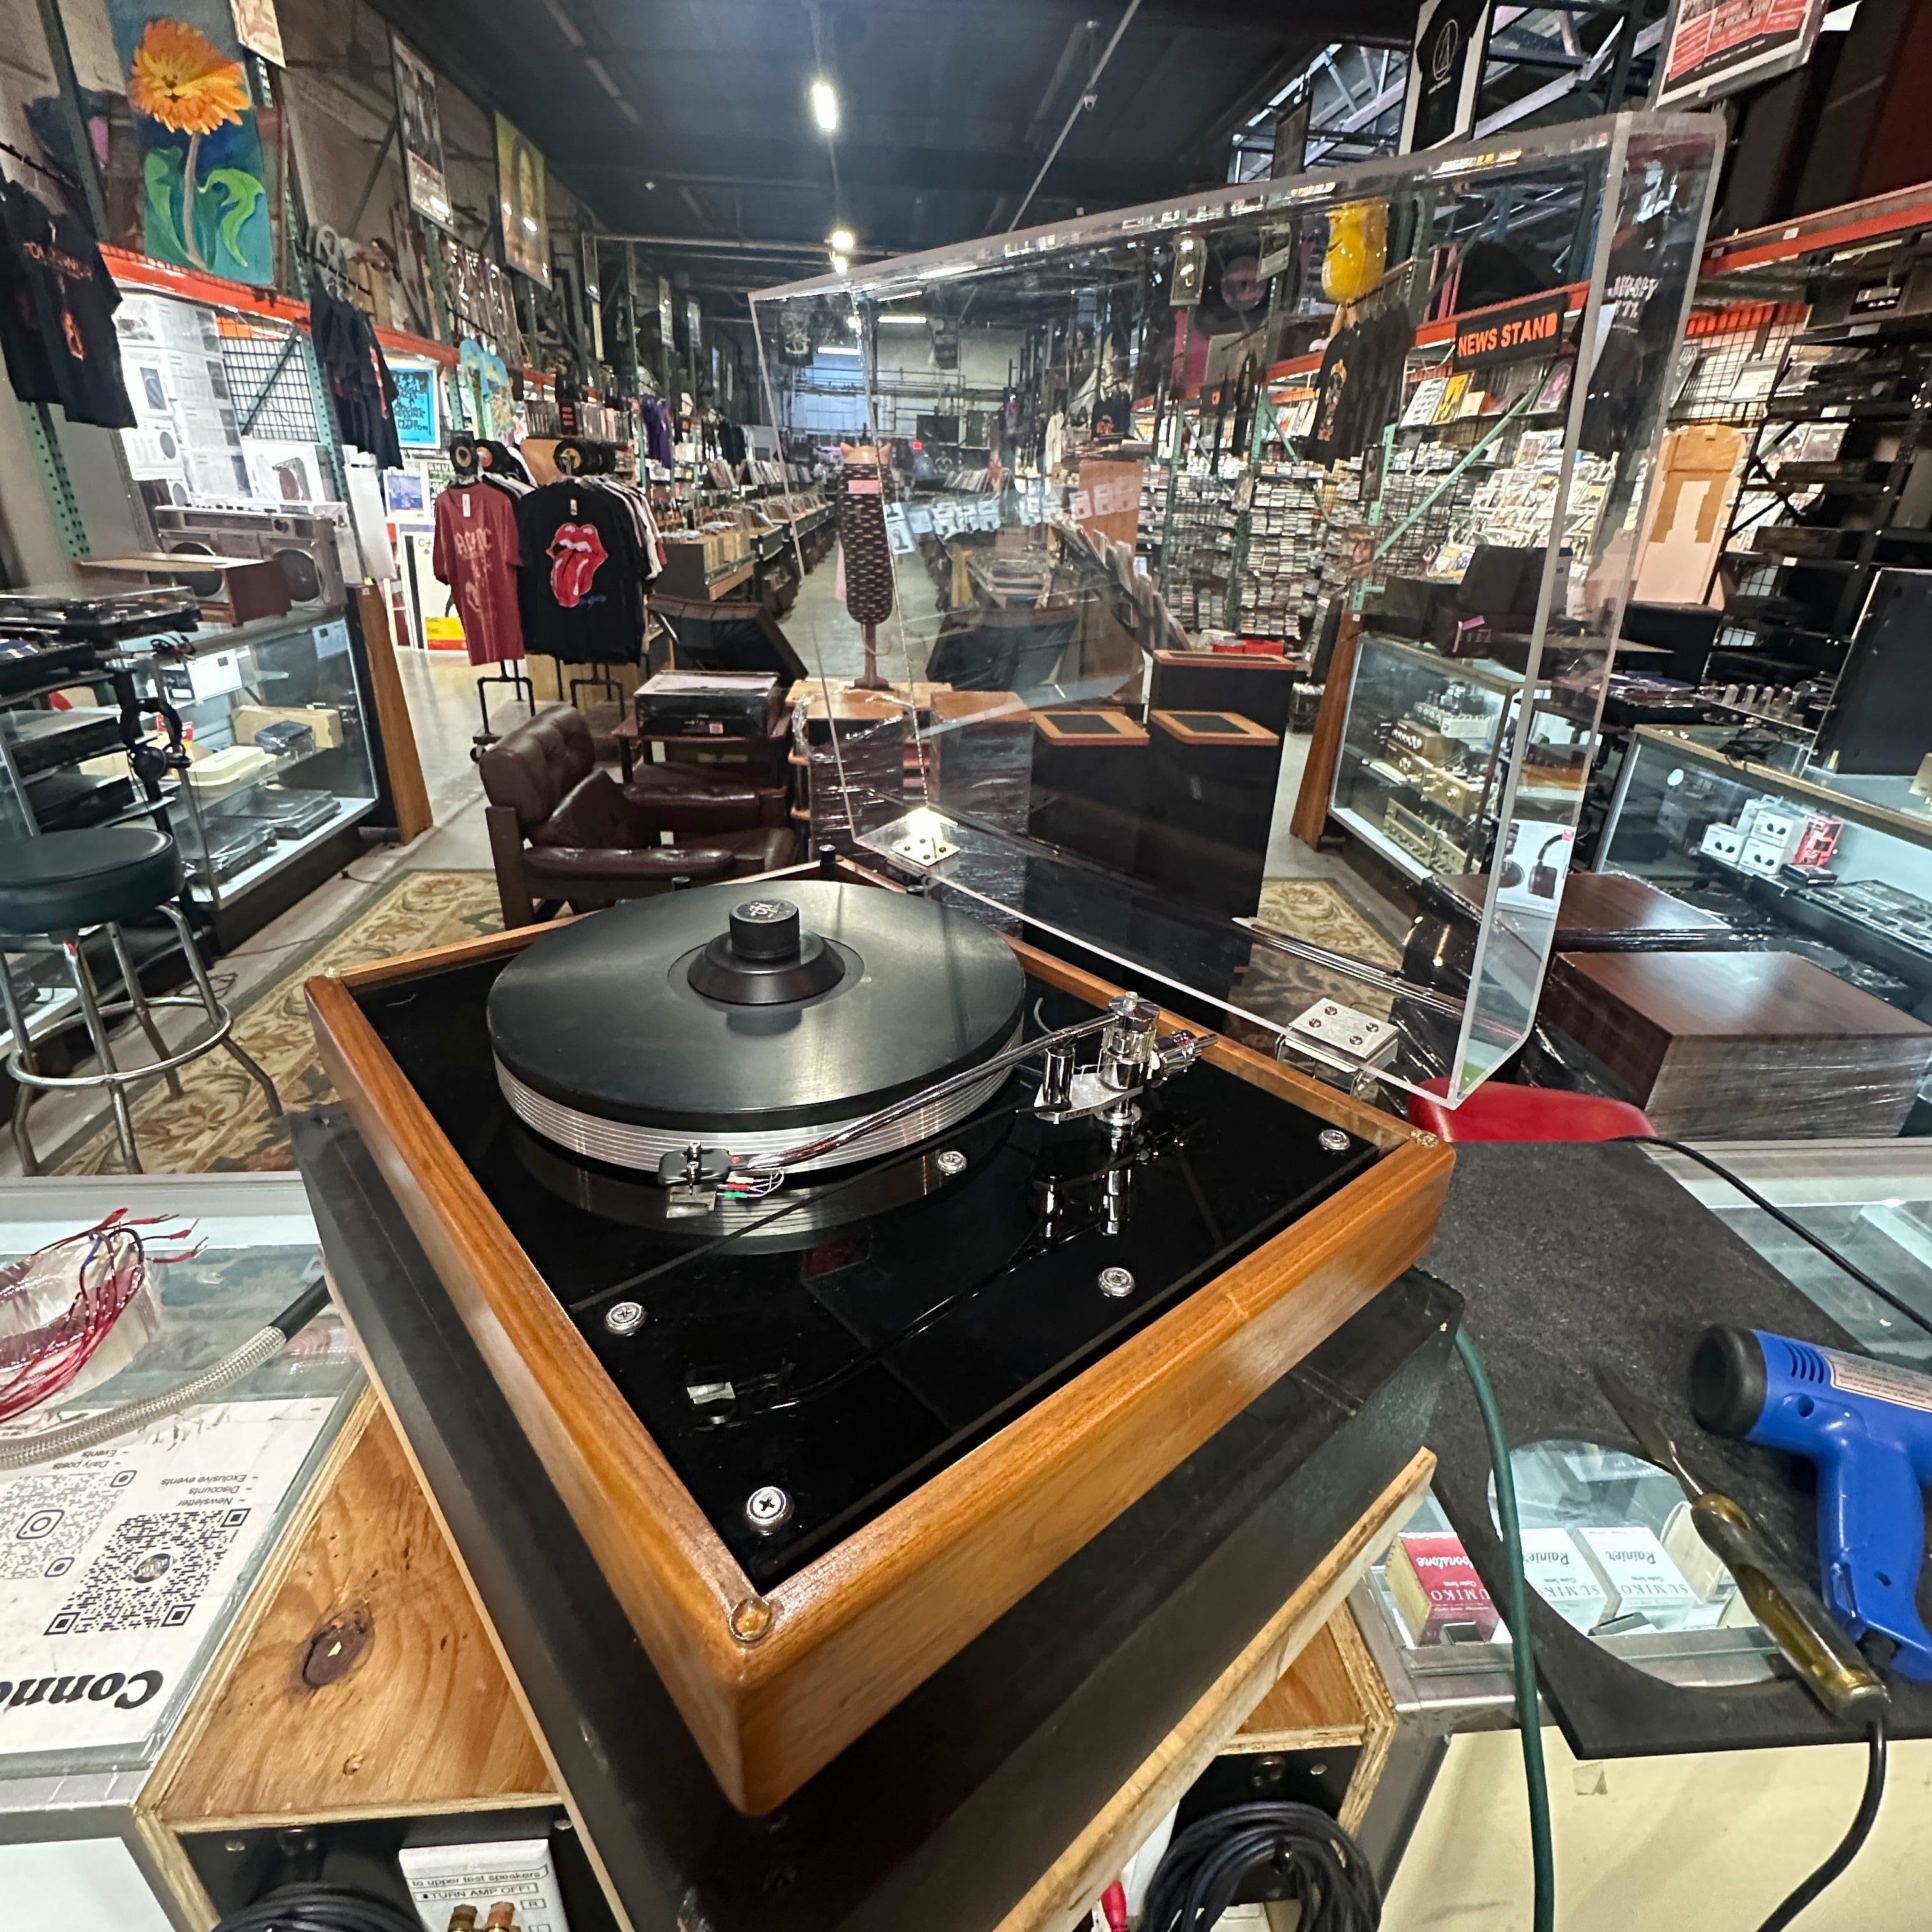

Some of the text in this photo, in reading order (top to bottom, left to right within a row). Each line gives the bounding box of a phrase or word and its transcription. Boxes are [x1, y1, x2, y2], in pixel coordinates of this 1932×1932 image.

[1459, 312, 1558, 357] NEWS STAND
[82, 1450, 117, 1458] Events
[52, 1460, 109, 1469] Daily posts
[160, 1475, 247, 1485] Exclusive events
[188, 1485, 240, 1494] Discounts
[176, 1497, 234, 1506] Newsletter
[1416, 1556, 1474, 1569] oonstone
[1606, 1551, 1656, 1565] Rainier
[1430, 1588, 1491, 1600] UMIKO
[1621, 1583, 1689, 1595] SUMIKO
[488, 1871, 540, 1881] speakers
[433, 1885, 530, 1899] TURN AMP OFF!
